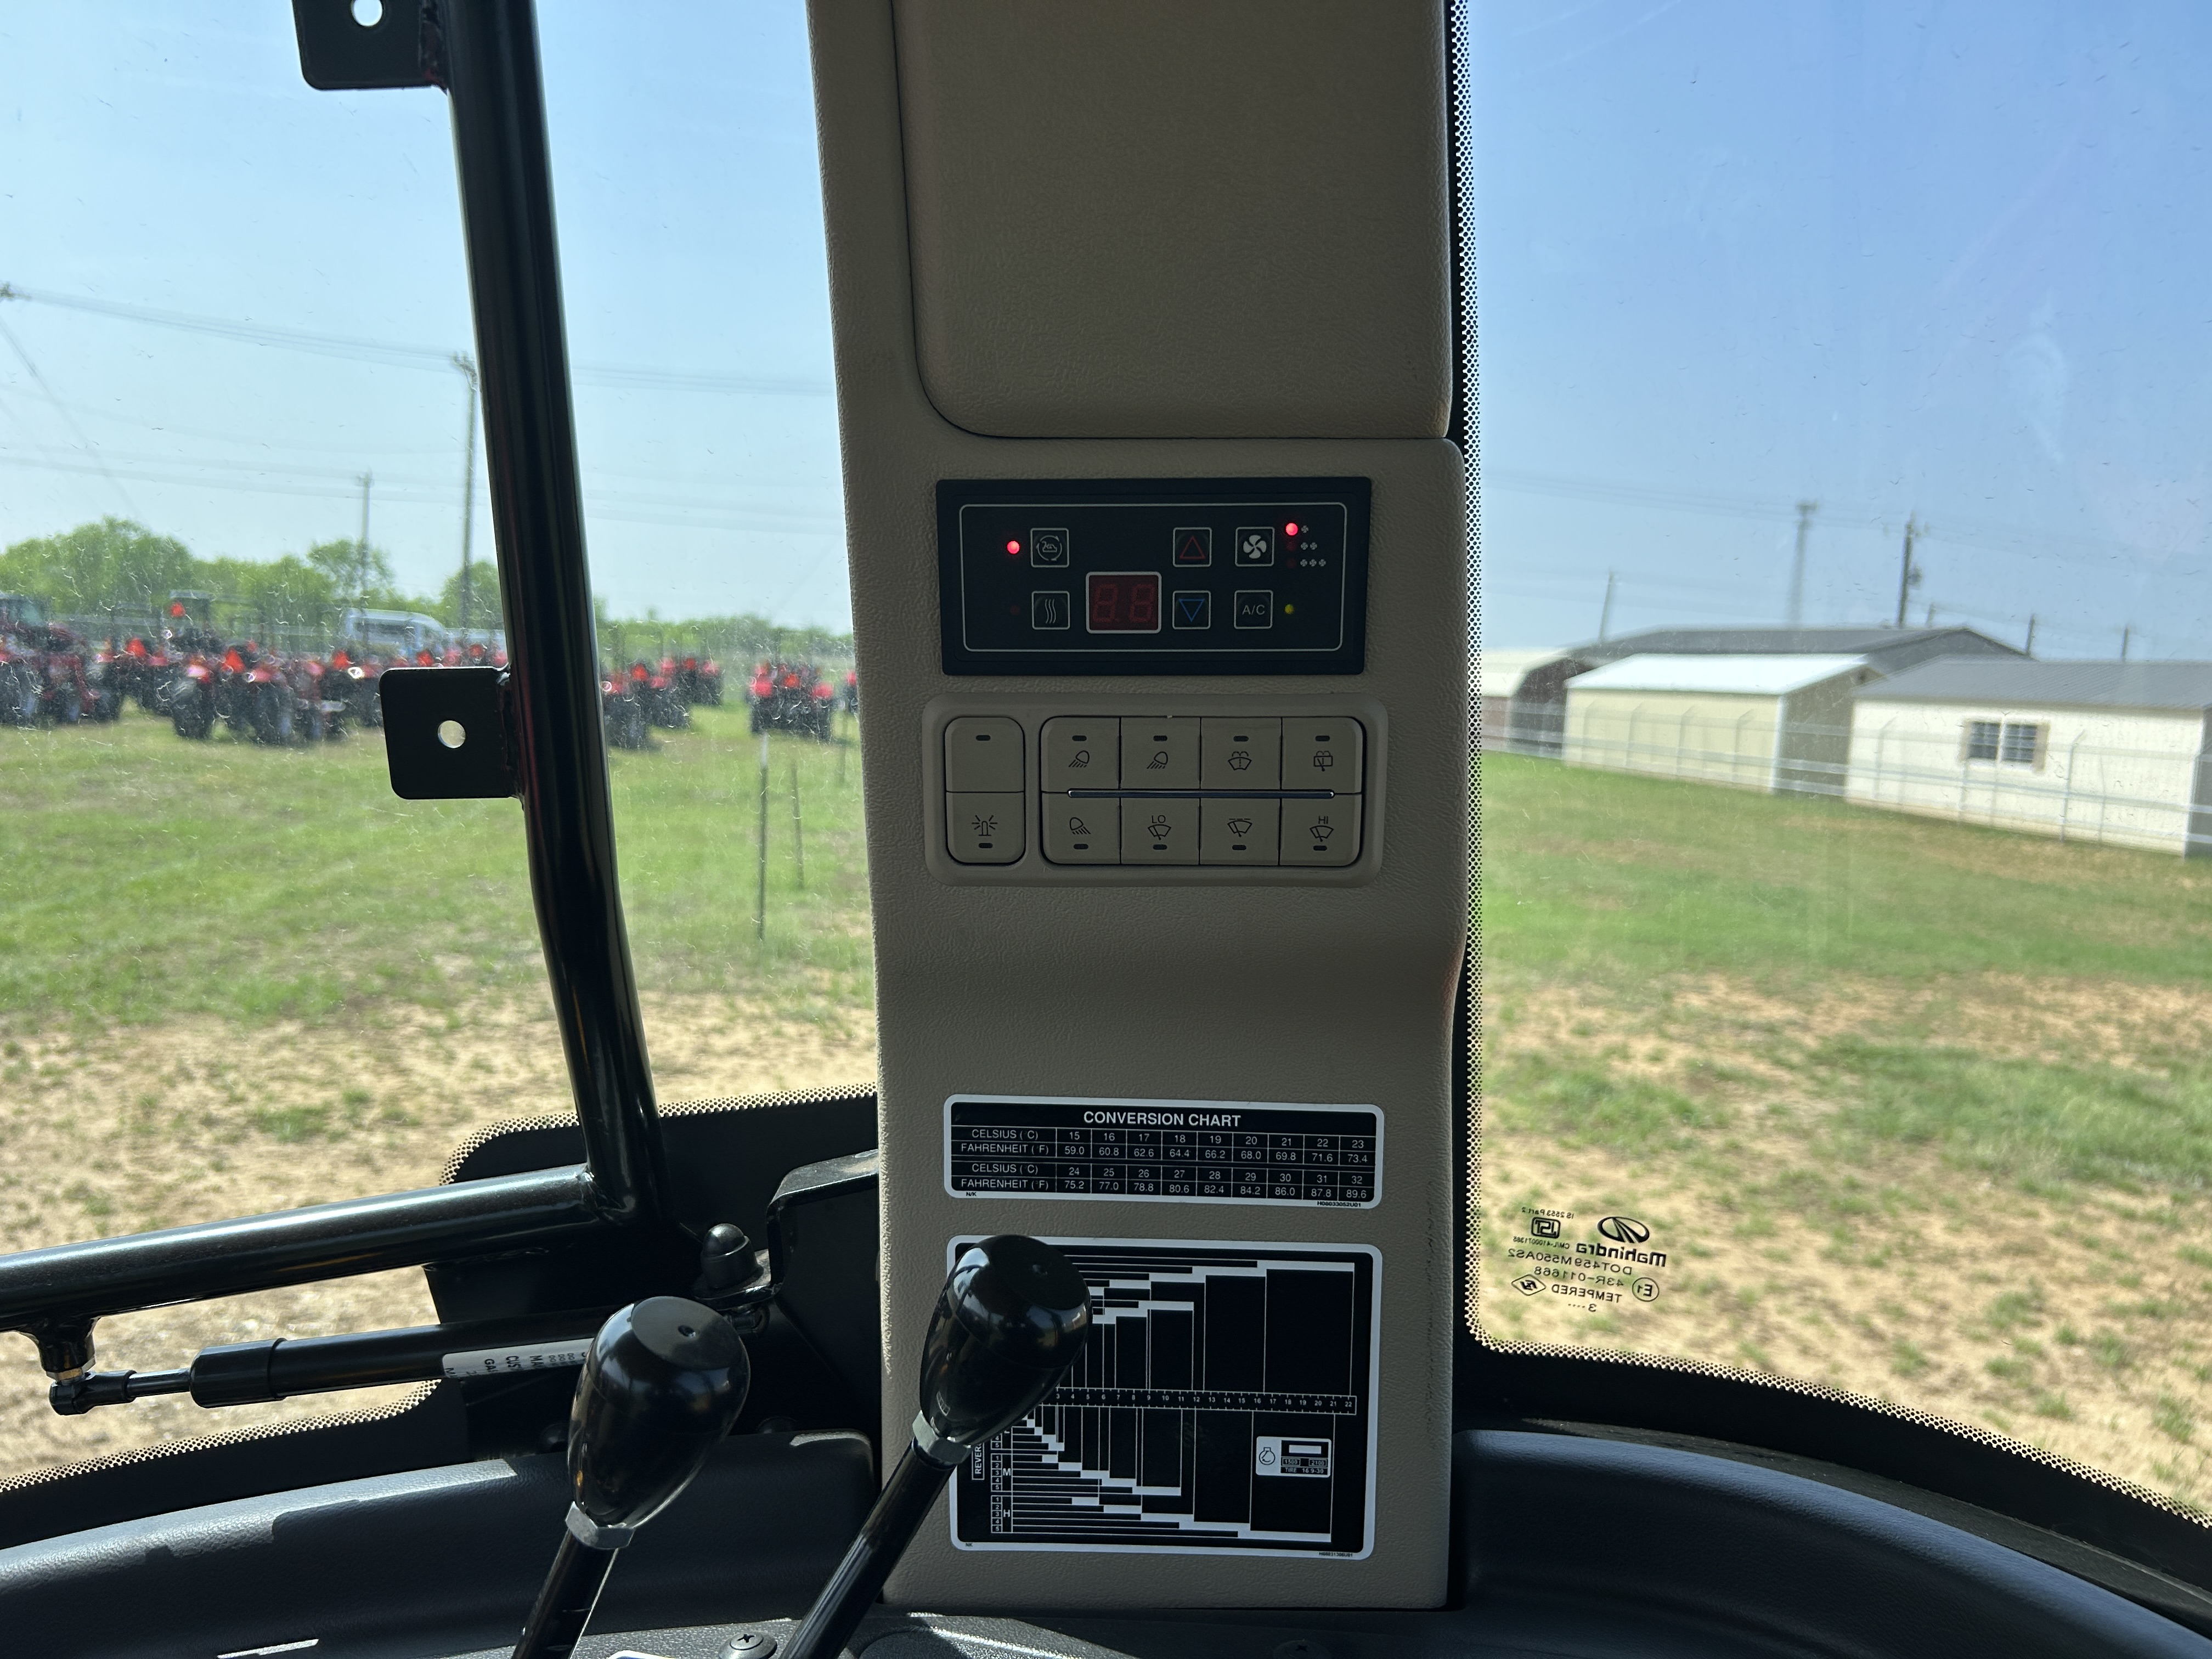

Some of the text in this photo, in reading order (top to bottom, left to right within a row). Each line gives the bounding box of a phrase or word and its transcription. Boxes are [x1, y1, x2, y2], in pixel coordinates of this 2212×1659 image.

[1242, 605, 1265, 615] A/C
[1152, 815, 1166, 823] LO
[1318, 816, 1328, 825] HI
[1084, 1111, 1241, 1126] CONVERSION CHART
[972, 1128, 1017, 1138] CELSIUS
[1069, 1131, 1080, 1140] 15
[1104, 1132, 1115, 1141] 16
[1139, 1133, 1149, 1142] 17
[1175, 1135, 1186, 1143] 18
[1210, 1135, 1221, 1144] 19
[1245, 1136, 1257, 1145] 20
[1282, 1137, 1291, 1146] 21
[1317, 1138, 1328, 1147] 22
[1352, 1140, 1364, 1148] 23
[961, 1143, 1028, 1153] FAHRENHEIT
[1065, 1146, 1085, 1155] 59.0
[1099, 1147, 1119, 1156] 60.8
[1134, 1148, 1154, 1157] 62.6
[1170, 1149, 1189, 1158] 64.4
[1205, 1150, 1225, 1159] 66.2
[1241, 1150, 1261, 1159] 68.0
[1276, 1152, 1296, 1160] 69.8
[1312, 1153, 1333, 1162] 71.6
[1347, 1154, 1368, 1163] 73.4
[972, 1164, 1017, 1173] CELSIUS
[1069, 1167, 1080, 1175] 24
[1104, 1168, 1114, 1177] 25
[1138, 1169, 1149, 1178] 26
[1174, 1170, 1185, 1178] 27
[1209, 1171, 1221, 1180] 28
[1245, 1172, 1256, 1181] 29
[1280, 1173, 1291, 1182] 30
[1317, 1175, 1327, 1183] 31
[1352, 1176, 1362, 1184] 32
[961, 1179, 1028, 1188] FAHRENHEIT
[1065, 1181, 1084, 1189] 75.2
[1099, 1182, 1119, 1190] 77.0
[1134, 1183, 1154, 1192] 78.8
[1169, 1184, 1189, 1193] 80.6
[1204, 1185, 1224, 1193] 82.4
[1240, 1186, 1260, 1195] 84.2
[1275, 1187, 1295, 1195] 86.0
[1311, 1188, 1331, 1198] 87.8
[1346, 1189, 1367, 1198] 89.6
